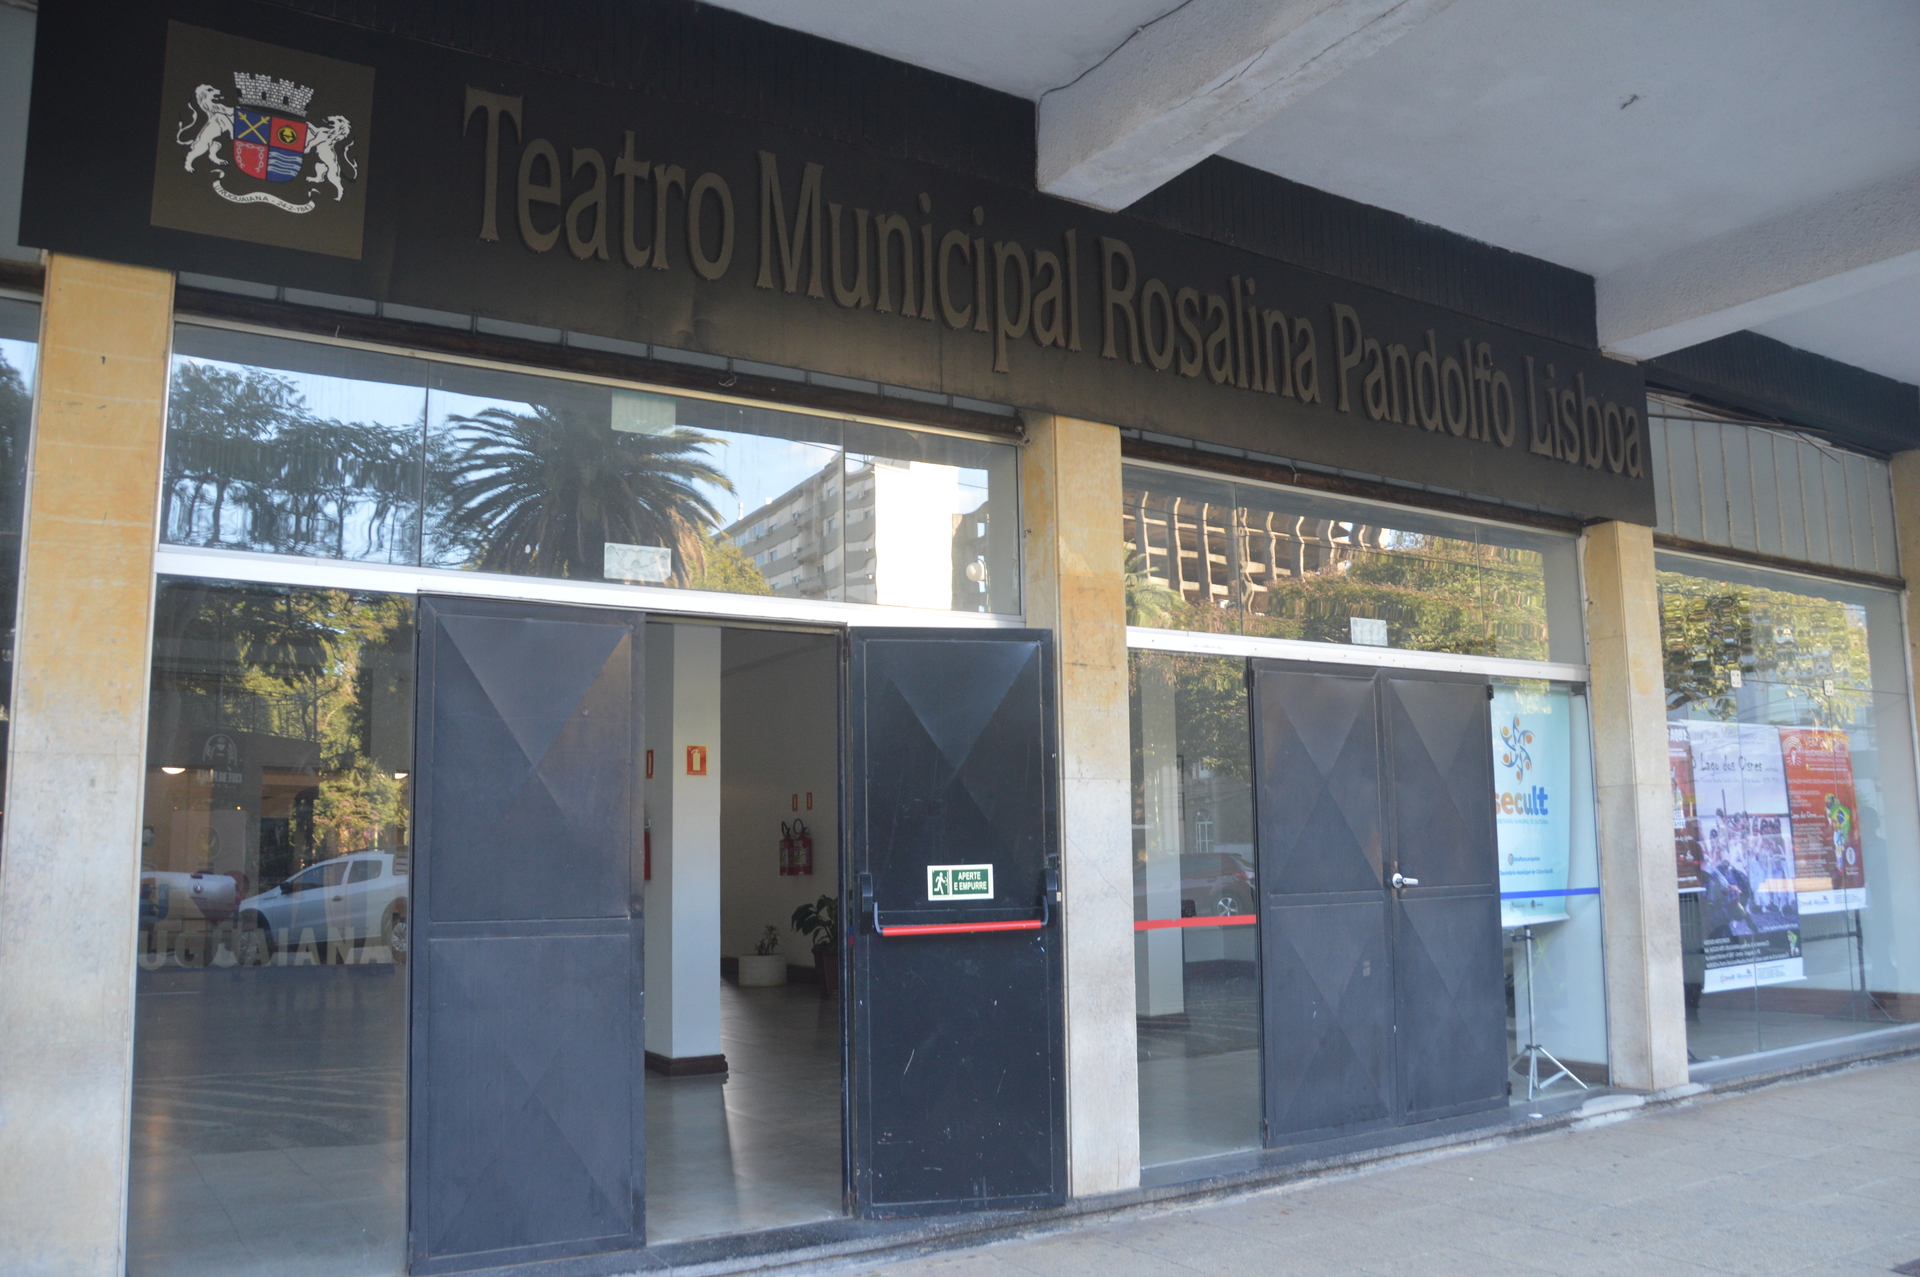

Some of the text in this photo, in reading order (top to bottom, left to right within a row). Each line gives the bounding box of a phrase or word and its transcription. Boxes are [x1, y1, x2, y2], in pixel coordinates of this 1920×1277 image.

[214, 184, 269, 203] URUGUAIANA
[462, 84, 1644, 479] Teatro Municipal Rosalina Pandolfo Lisboa
[1700, 752, 1719, 776] Lago
[1723, 755, 1735, 772] dos
[954, 881, 987, 890] E EMPURRE
[958, 872, 981, 880] APERTE
